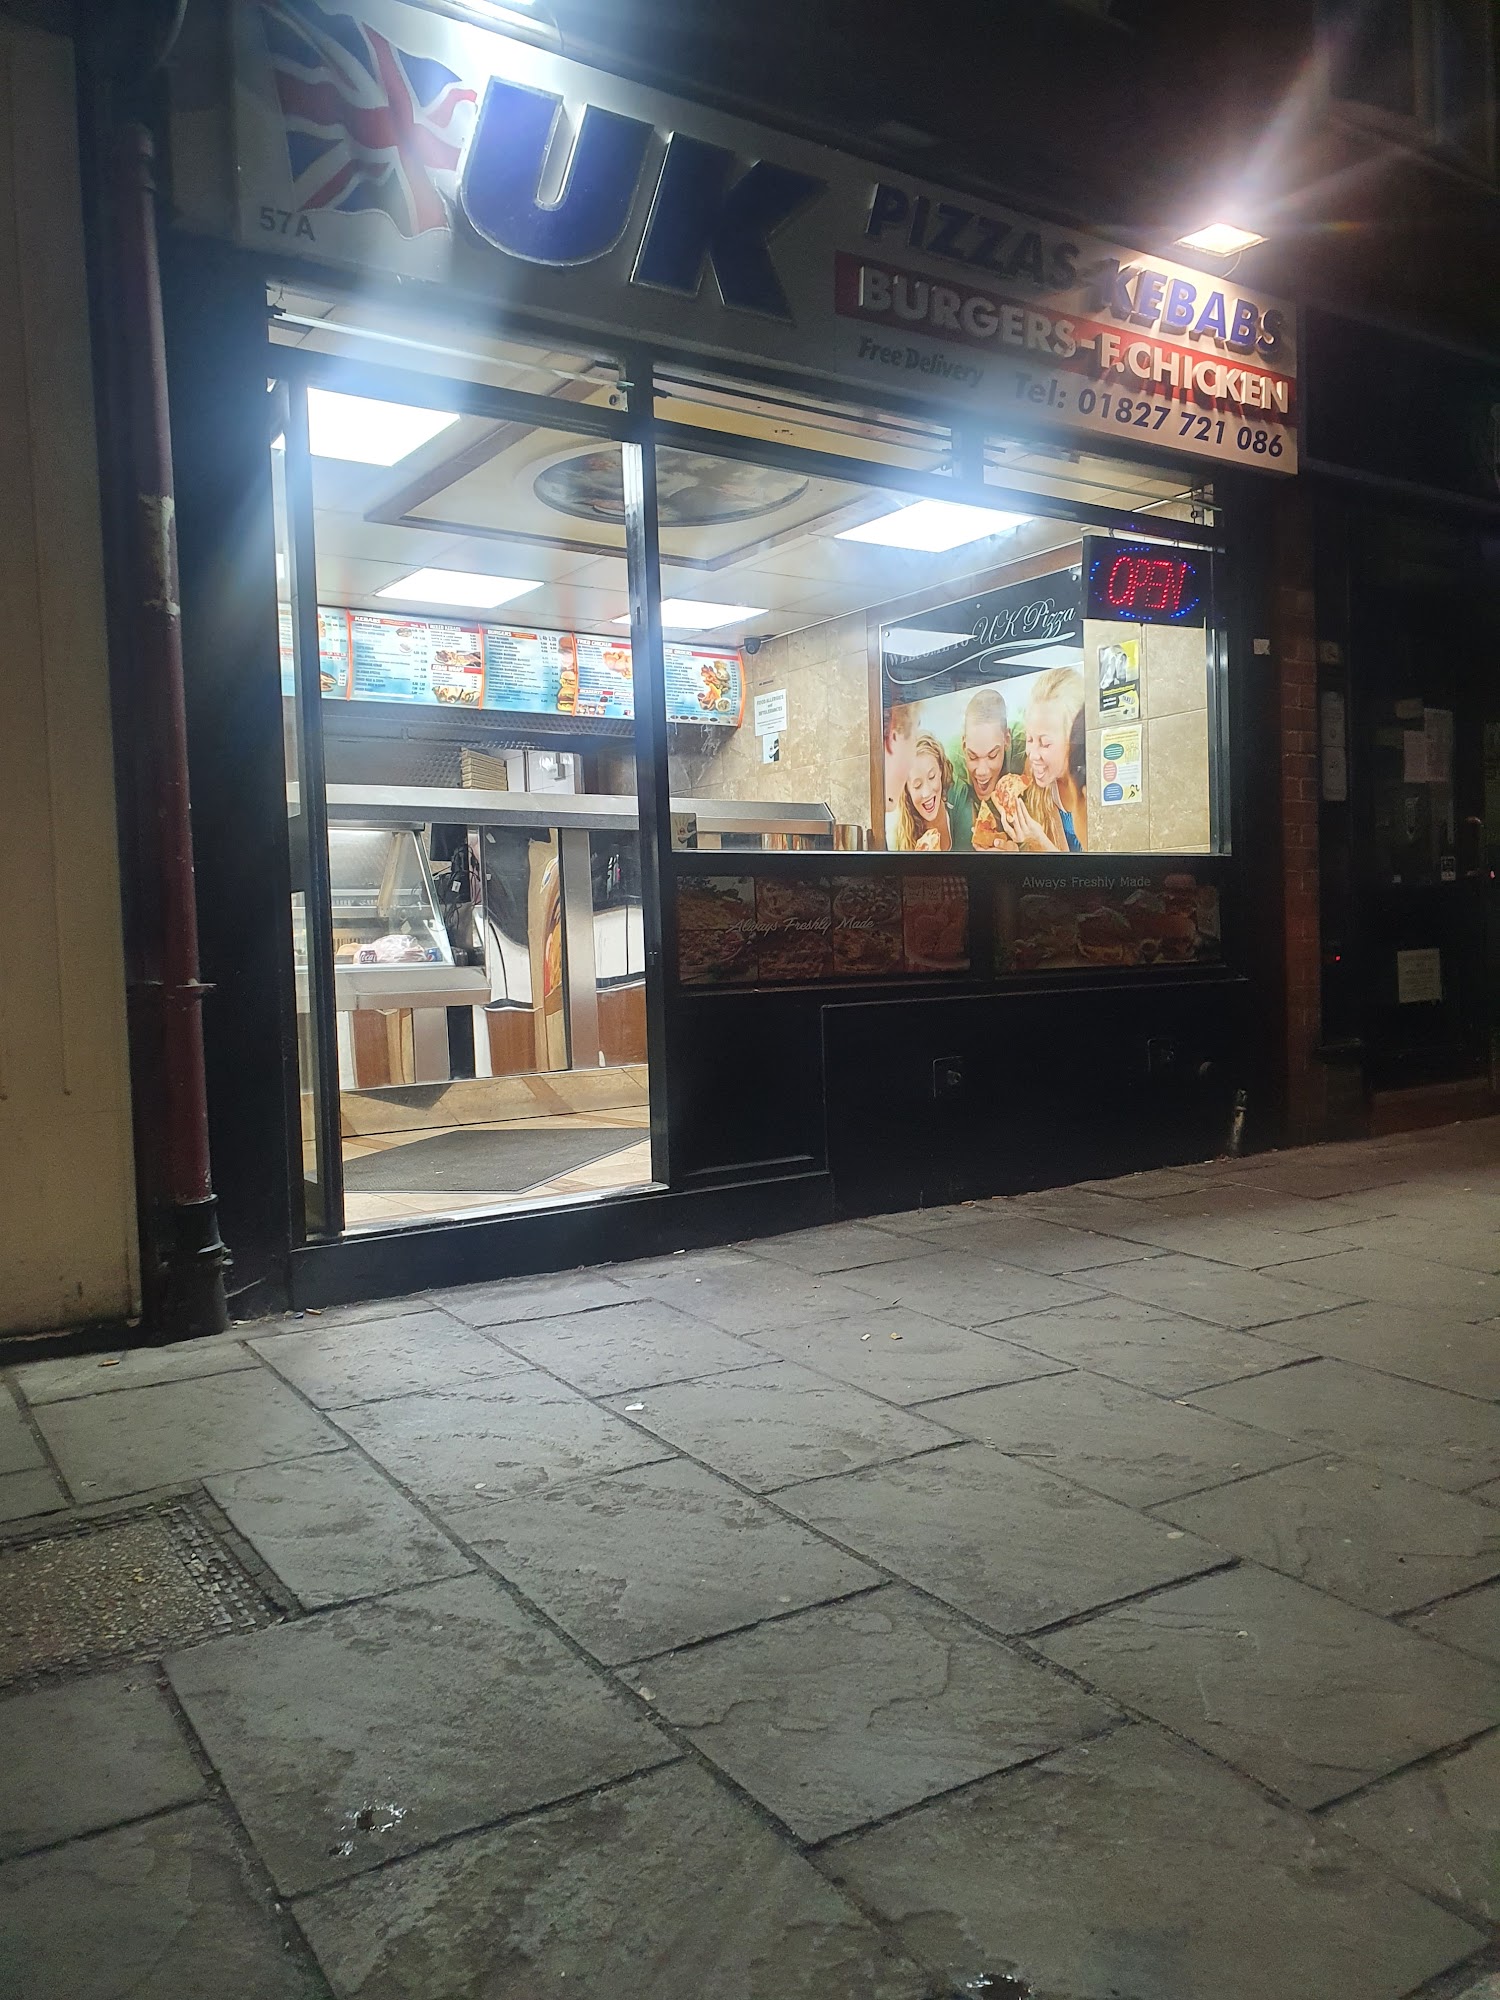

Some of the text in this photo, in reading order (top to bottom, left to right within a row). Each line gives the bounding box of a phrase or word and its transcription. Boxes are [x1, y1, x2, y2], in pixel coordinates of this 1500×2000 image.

[260, 206, 316, 242] 57A
[459, 75, 828, 325] UK
[865, 181, 1285, 362] PIZZAS KEBABS
[857, 335, 985, 388] Free Delivery
[1015, 371, 1284, 458] Tel: 01827 721 086
[1108, 556, 1187, 610] OPEN
[971, 606, 1028, 645] UK
[1022, 598, 1077, 640] Pizza
[1022, 876, 1151, 890] Always Freshly Made
[725, 916, 875, 936] Always Freshly Made
